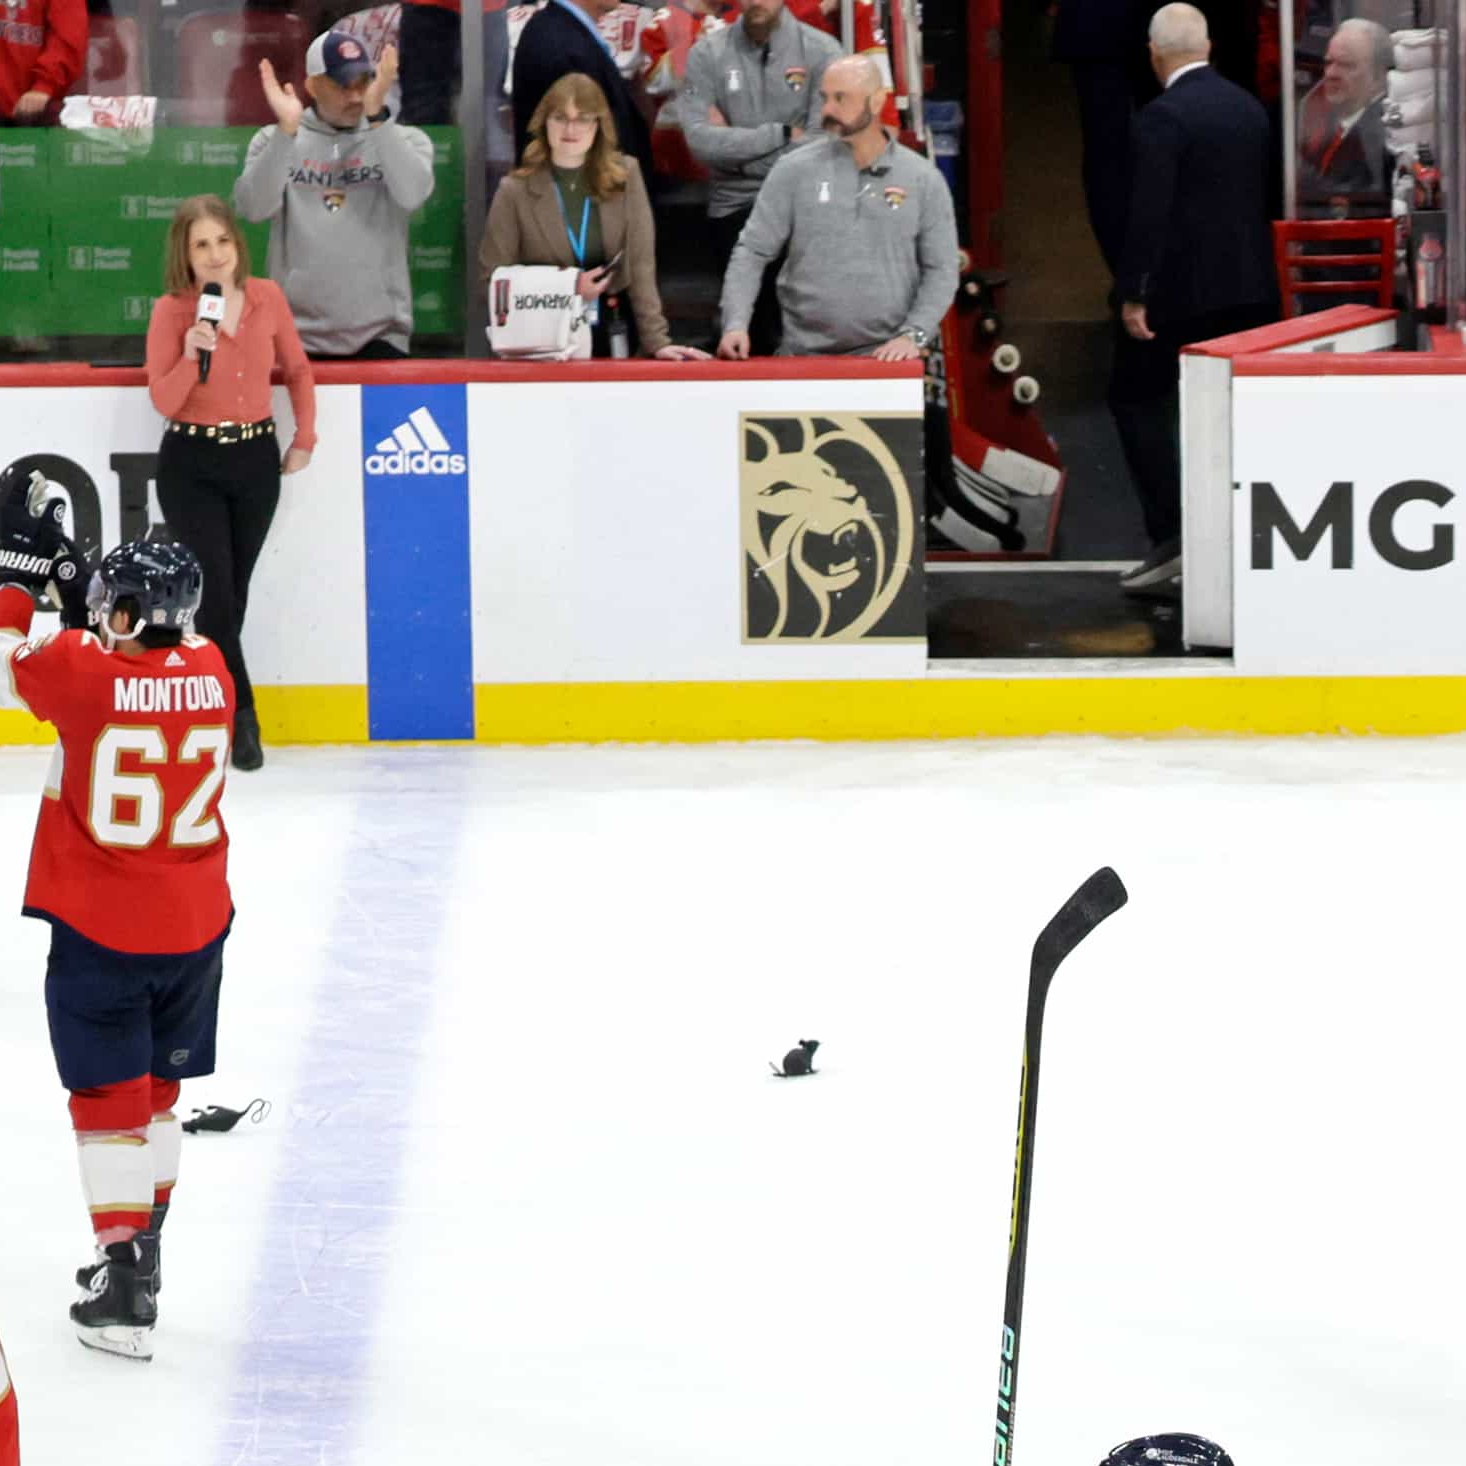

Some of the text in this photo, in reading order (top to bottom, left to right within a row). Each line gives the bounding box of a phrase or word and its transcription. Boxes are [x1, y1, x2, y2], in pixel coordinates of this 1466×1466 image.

[365, 449, 467, 476] adidas
[114, 675, 226, 712] MONTOUR
[87, 723, 229, 850] 62
